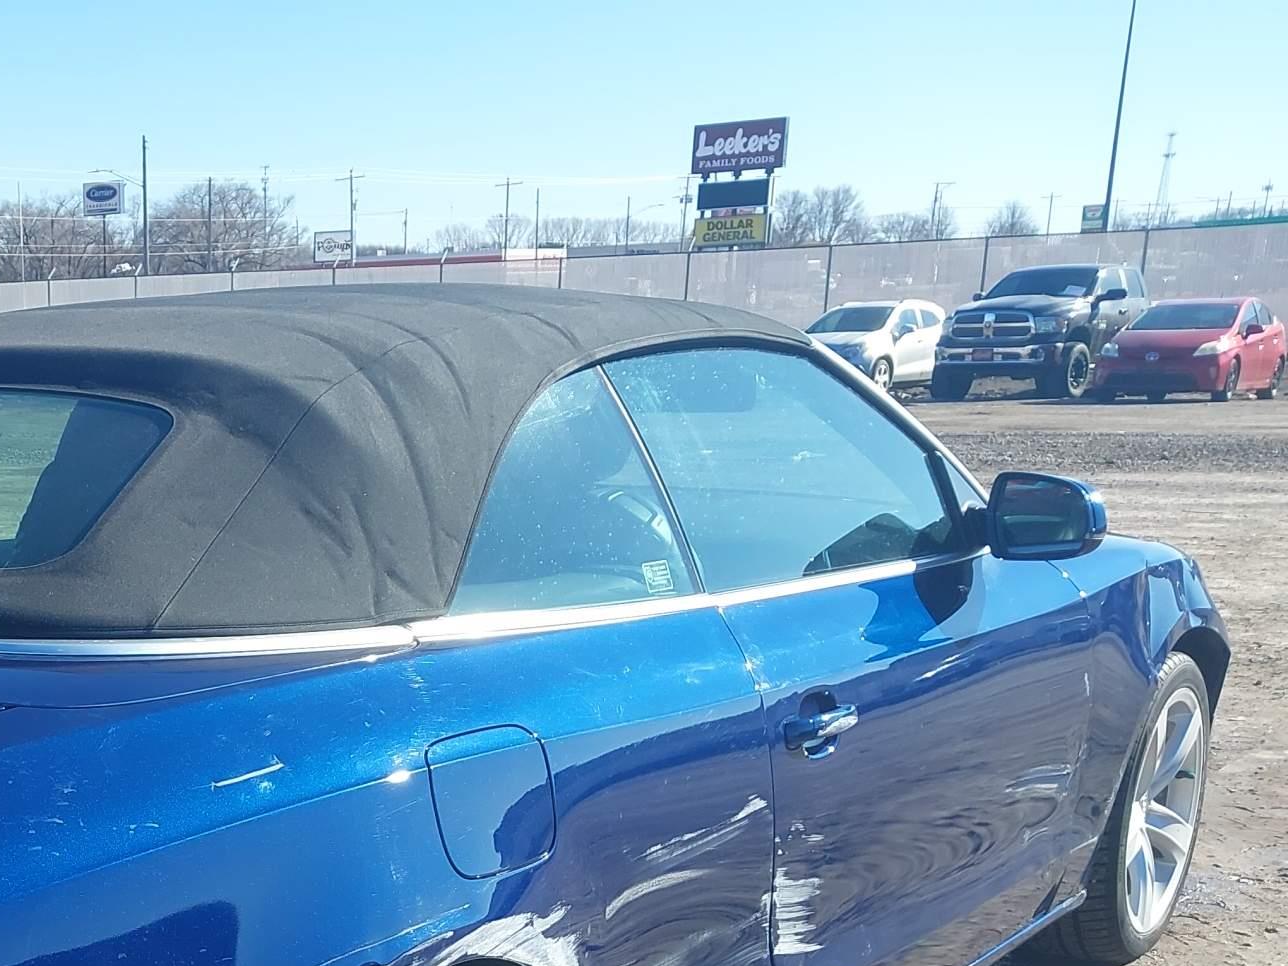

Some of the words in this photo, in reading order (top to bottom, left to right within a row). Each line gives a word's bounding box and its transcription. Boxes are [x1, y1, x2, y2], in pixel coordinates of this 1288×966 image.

[695, 127, 782, 157] Leeker's
[698, 158, 738, 169] FAMILY
[740, 154, 775, 166] FOODS
[706, 217, 754, 231] DOLLAR
[702, 229, 756, 242] GENERAL
